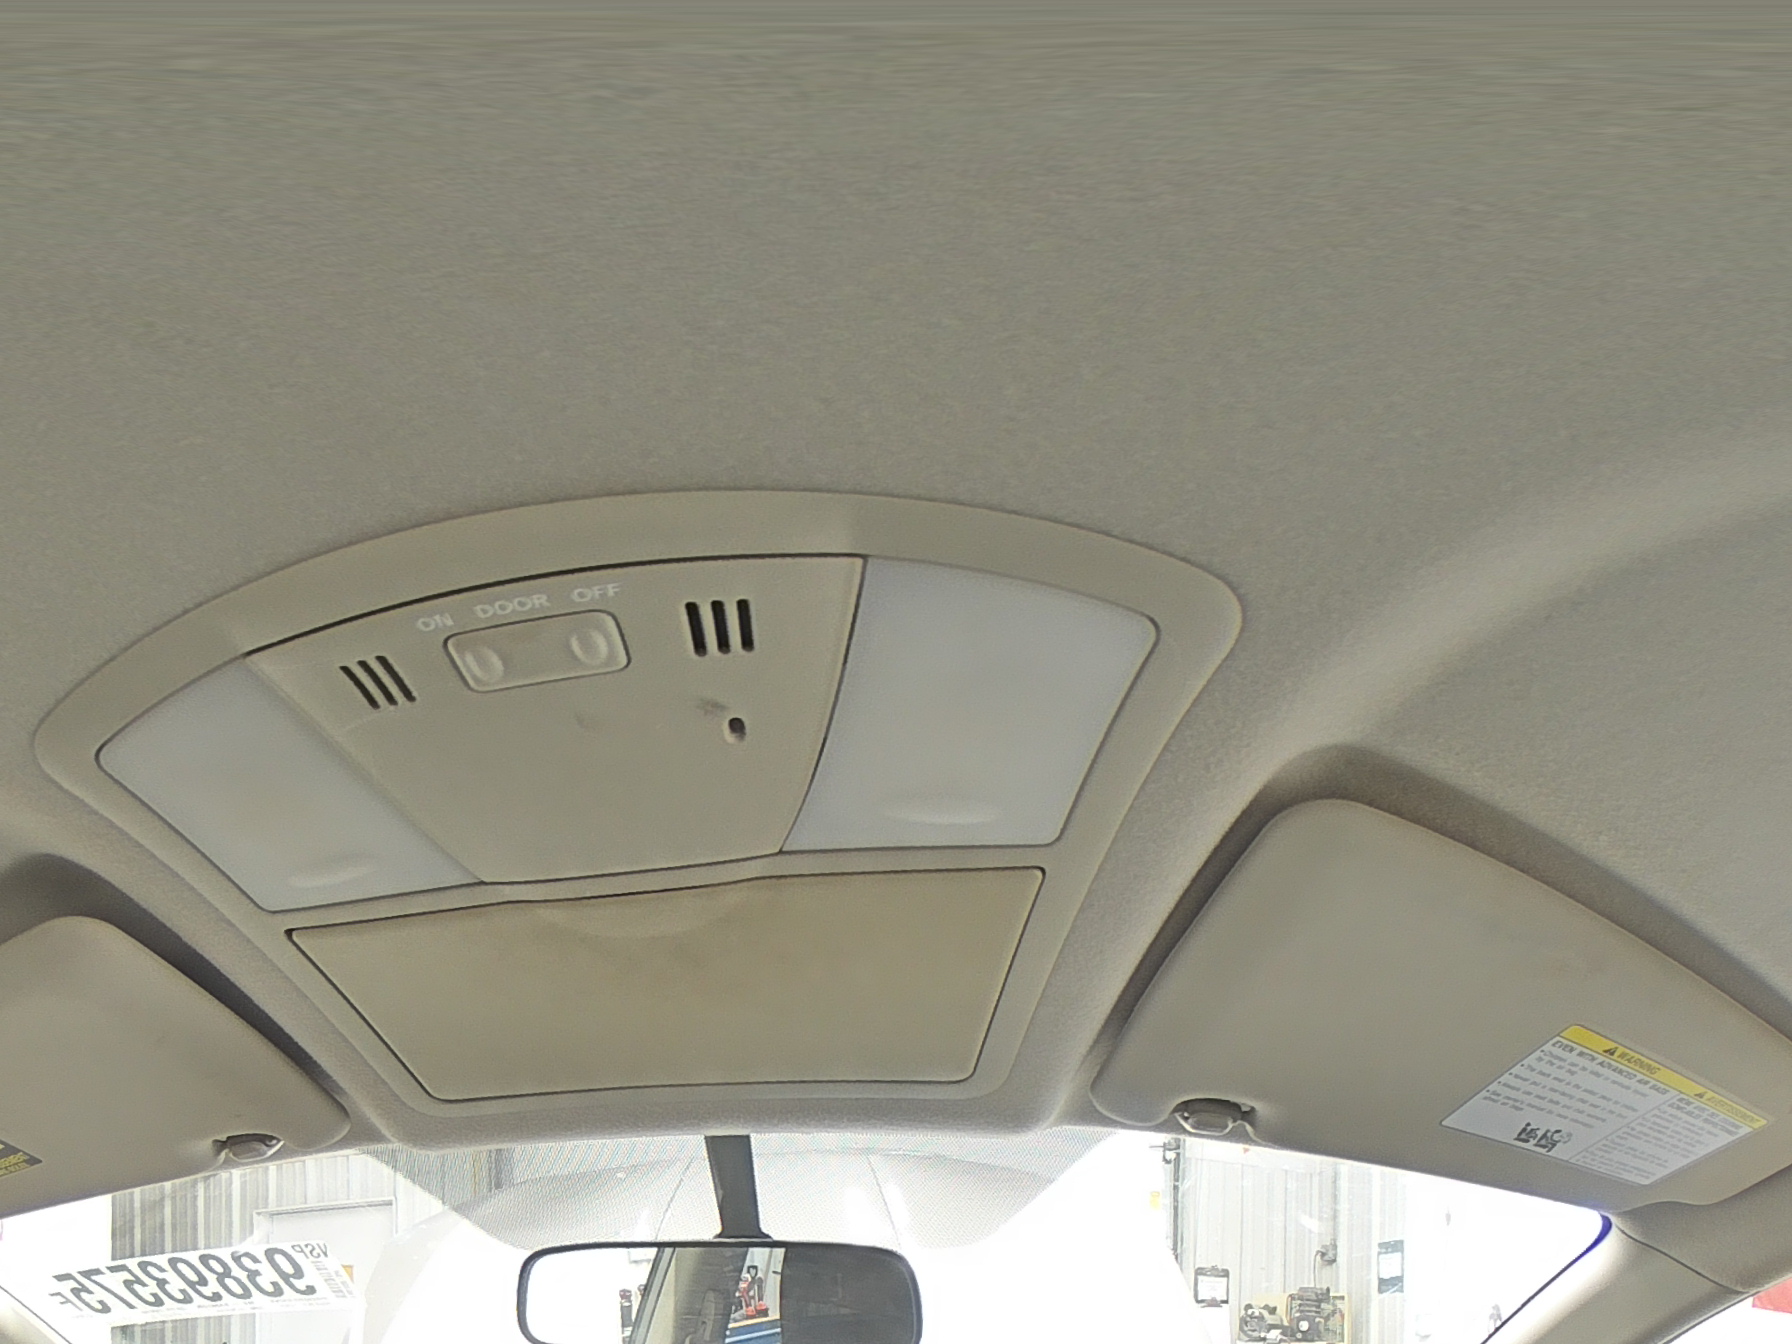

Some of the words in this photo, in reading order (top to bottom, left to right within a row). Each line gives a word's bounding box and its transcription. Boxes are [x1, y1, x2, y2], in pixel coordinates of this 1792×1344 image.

[417, 614, 455, 632] ON
[473, 594, 551, 619] DOOR
[572, 583, 621, 603] OFF
[1616, 1051, 1661, 1075] WARNING
